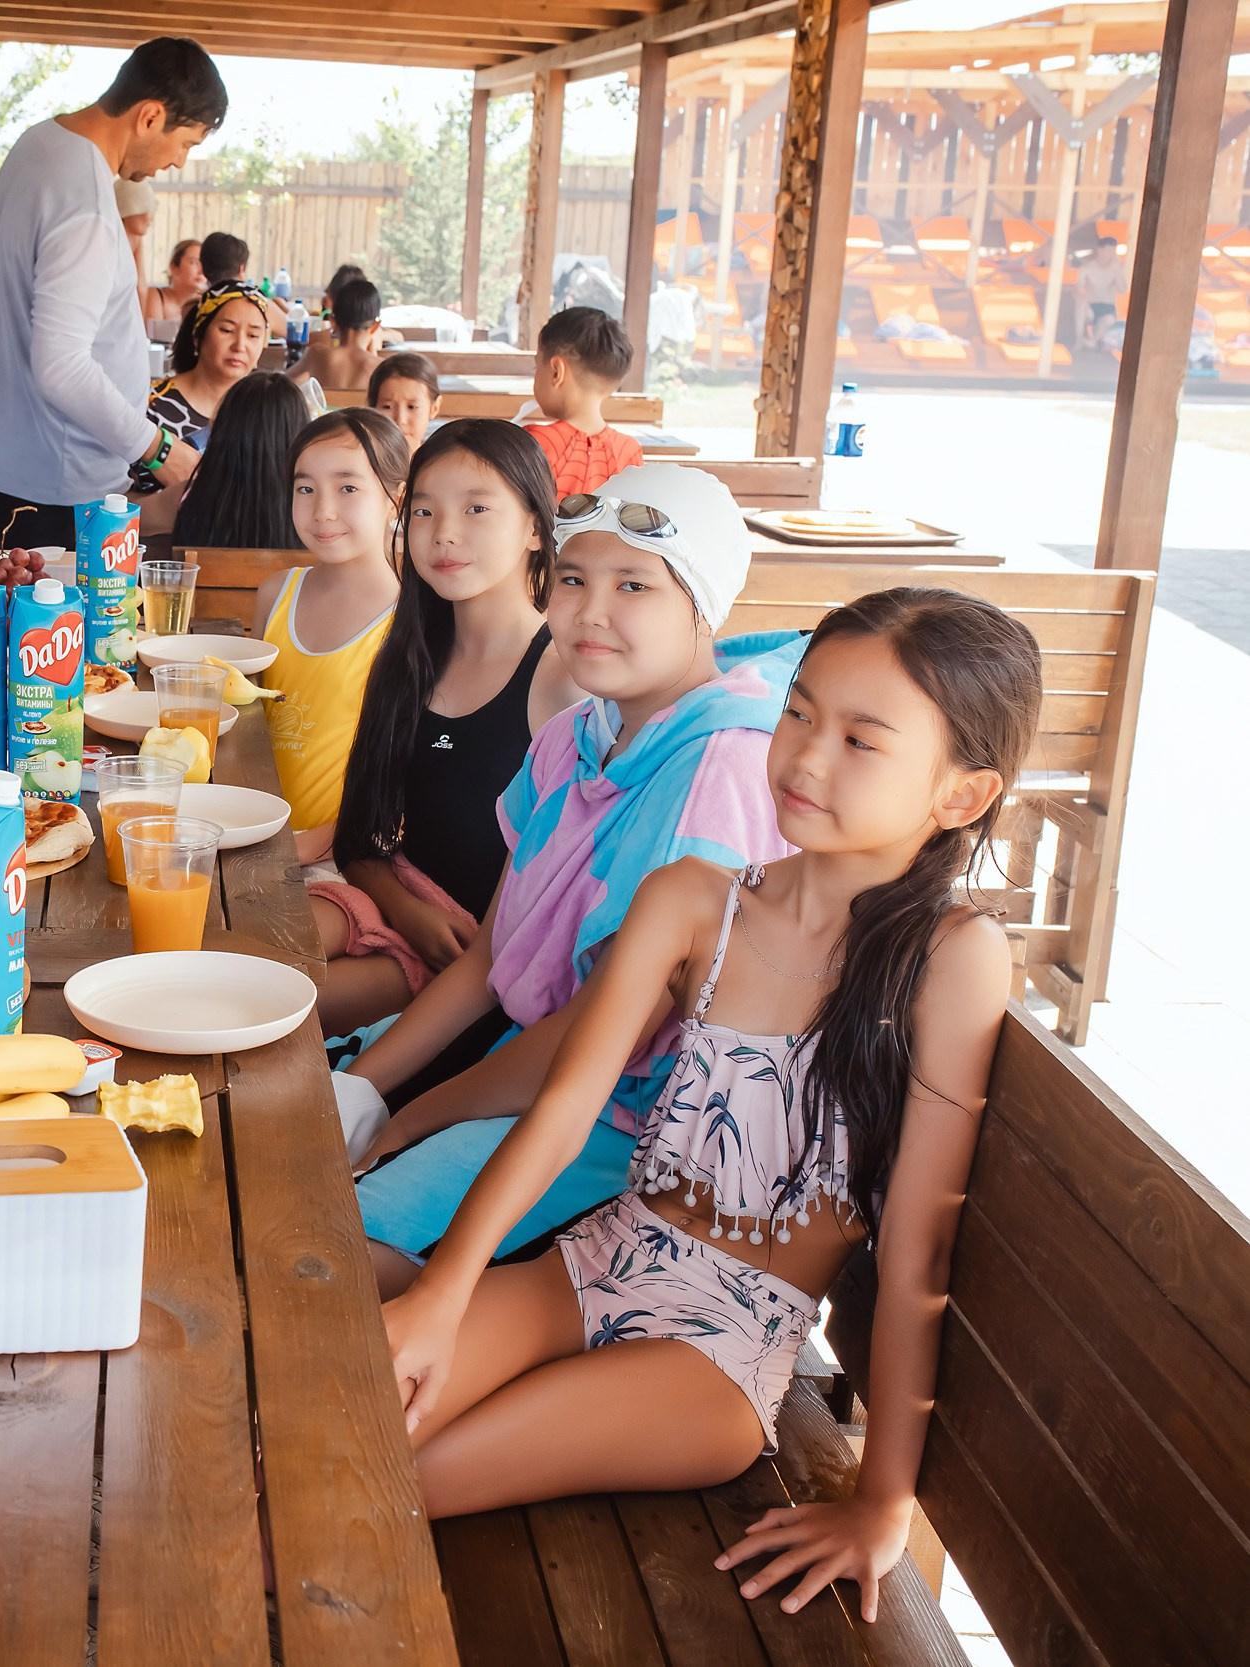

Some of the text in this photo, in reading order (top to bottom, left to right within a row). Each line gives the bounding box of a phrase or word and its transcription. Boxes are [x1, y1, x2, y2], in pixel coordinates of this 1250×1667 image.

[97, 576, 126, 588] ЭКСТРА
[19, 622, 83, 677] DaDa
[16, 684, 53, 699] ЭКСТРА
[16, 697, 53, 708] ВИТАМИНЫ
[431, 742, 454, 750] JOSS
